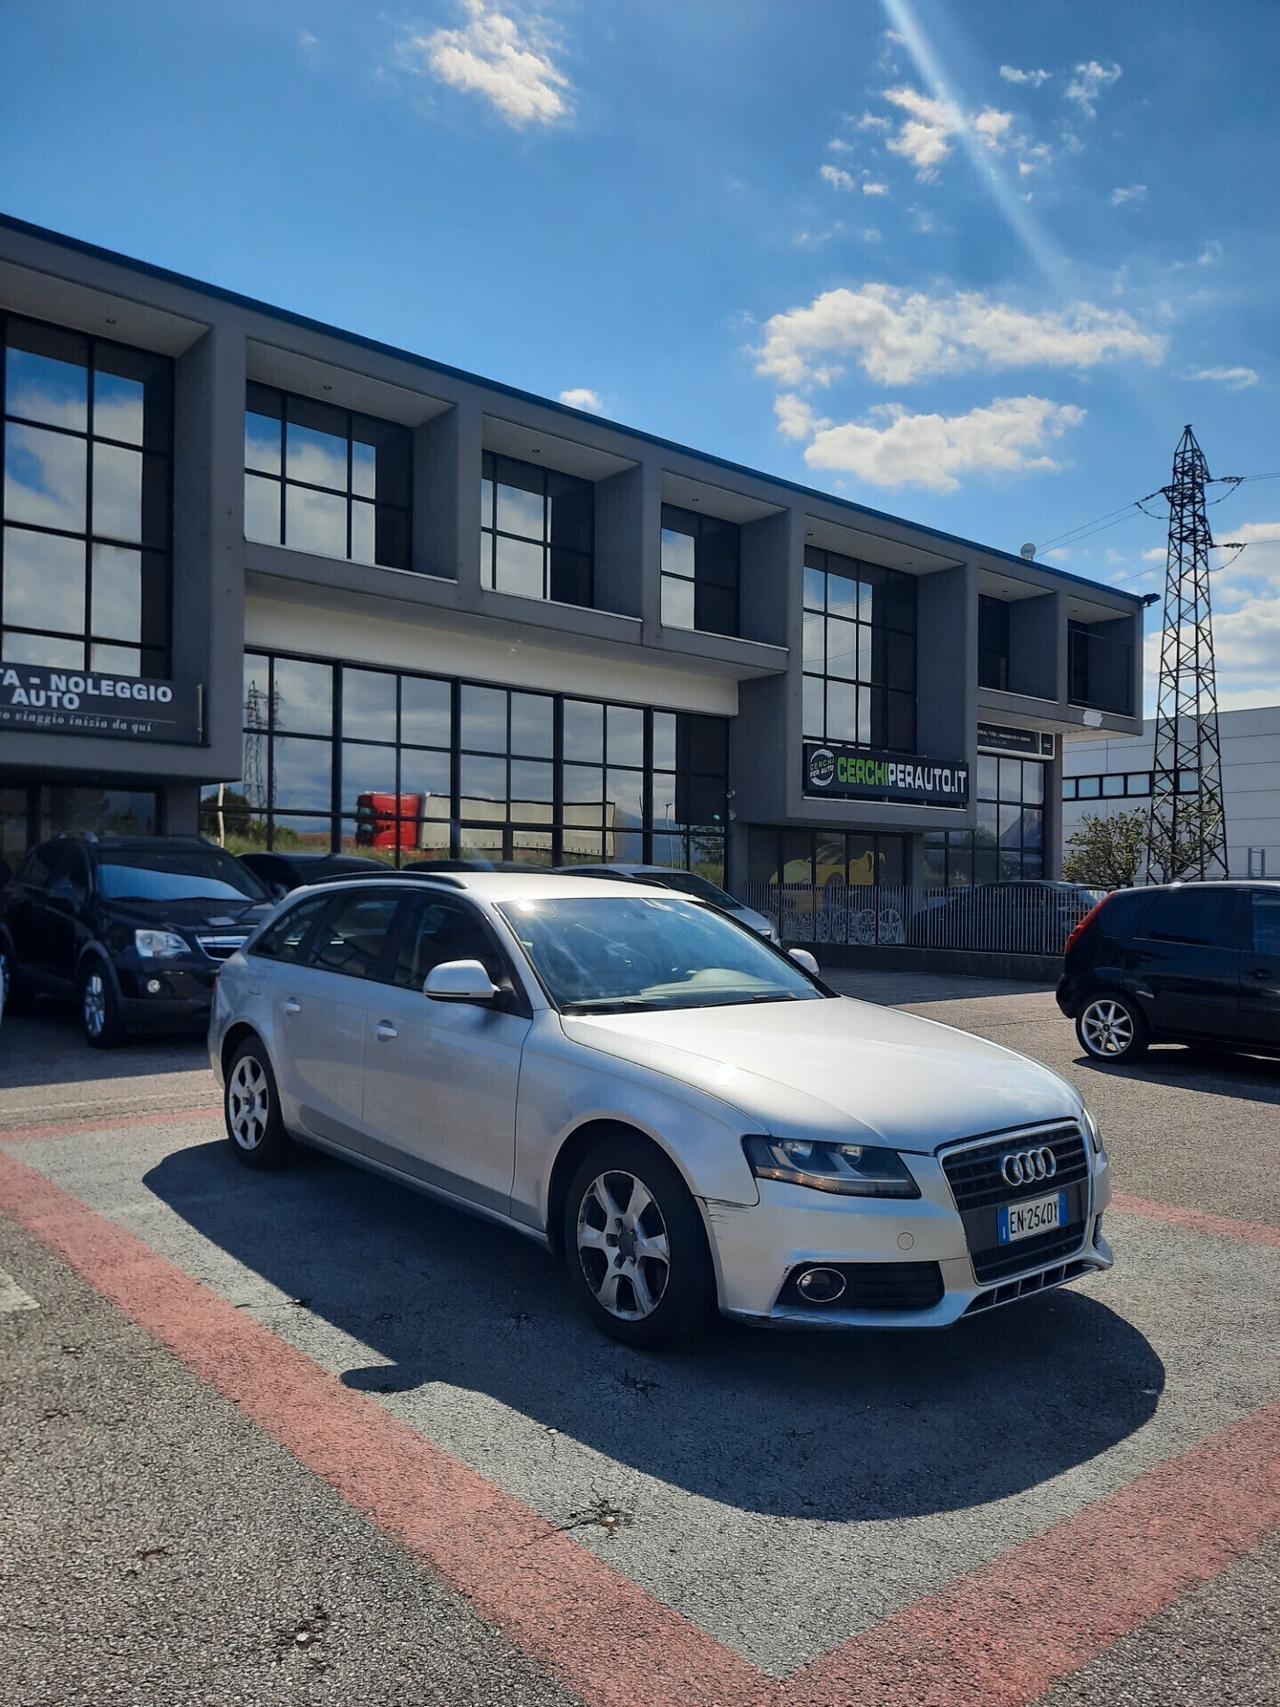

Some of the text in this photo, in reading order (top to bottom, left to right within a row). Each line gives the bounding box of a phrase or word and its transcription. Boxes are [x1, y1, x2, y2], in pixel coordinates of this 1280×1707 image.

[11, 688, 80, 710] AUTO
[50, 674, 173, 702] NOLEGGIO
[16, 711, 65, 726] viaggio
[69, 715, 108, 729] inizia
[112, 719, 127, 730] da
[131, 722, 153, 734] qui
[837, 756, 967, 793] CERCHIPERAUTO.IT
